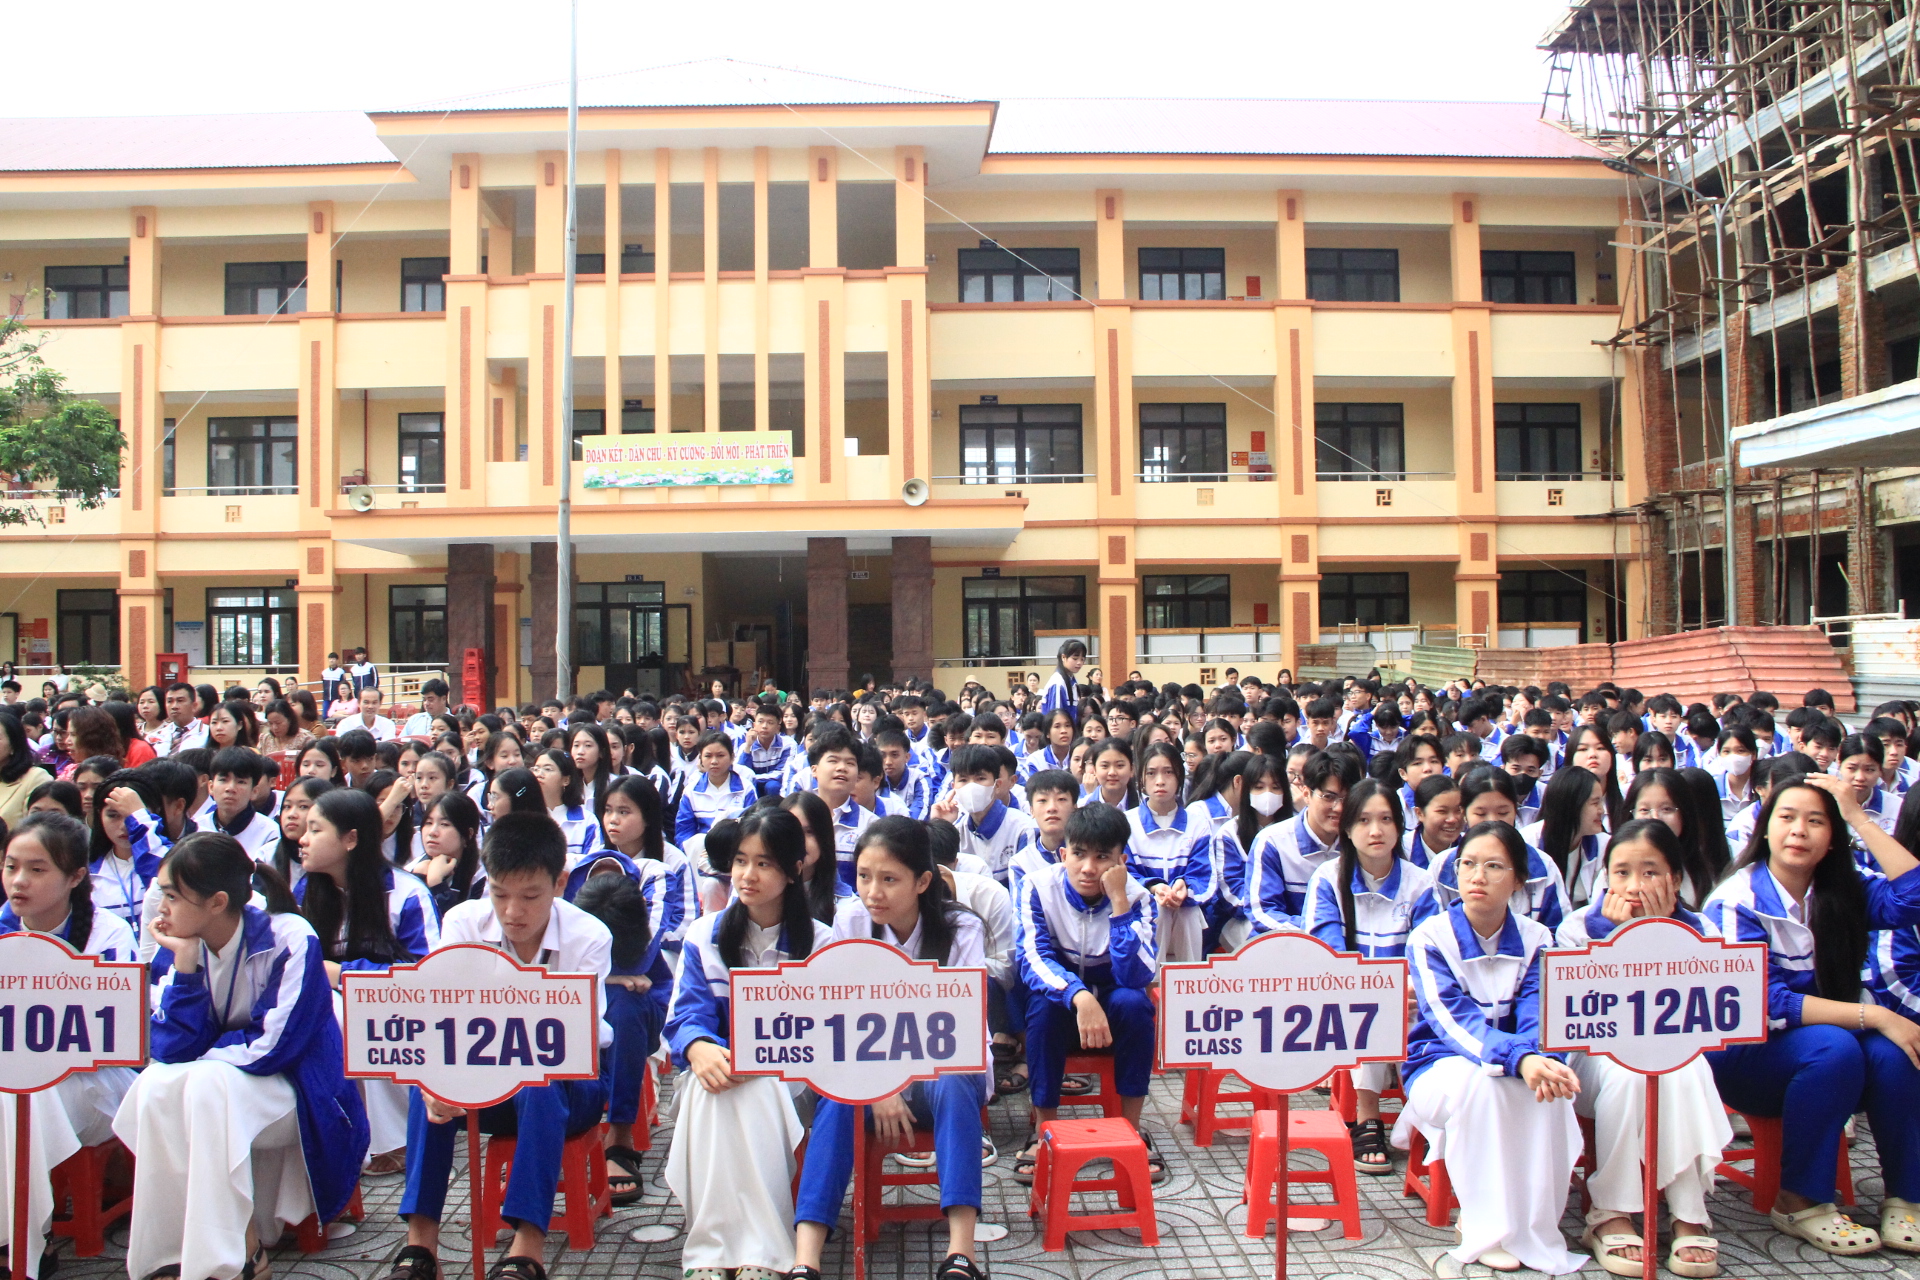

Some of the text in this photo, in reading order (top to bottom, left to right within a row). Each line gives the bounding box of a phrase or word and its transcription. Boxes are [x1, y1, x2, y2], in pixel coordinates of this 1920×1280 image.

[585, 445, 607, 463] ĐOÀN
[608, 442, 623, 462] KẾT
[629, 444, 644, 461] DÂN
[647, 441, 662, 461] CHỦ
[745, 441, 765, 459] PHÁT
[1556, 955, 1755, 981] TRƯỜNG THPT HƯỚNG HÓA
[32, 972, 92, 990] HƯỚNG
[98, 973, 131, 990] HÓA
[743, 979, 973, 1001] TRƯỜNG THPT HƯỚNG HÓA
[1175, 971, 1394, 994] TRƯỜNG THPT HƯỚNG HÓA
[355, 984, 582, 1004] TRƯỜNG THPT HƯỚNG HÓA
[1566, 986, 1740, 1035] LỚP 12A6
[0, 1005, 115, 1052] 10A1
[755, 1012, 956, 1061] LỚP 12A8
[1186, 1003, 1378, 1052] LỚP 12A7
[1566, 1021, 1617, 1040] CLASS
[367, 1014, 565, 1066] LỚP 12A9
[1186, 1038, 1242, 1055] CLASS
[368, 1048, 425, 1065] CLASS
[756, 1046, 814, 1063] CLASS
